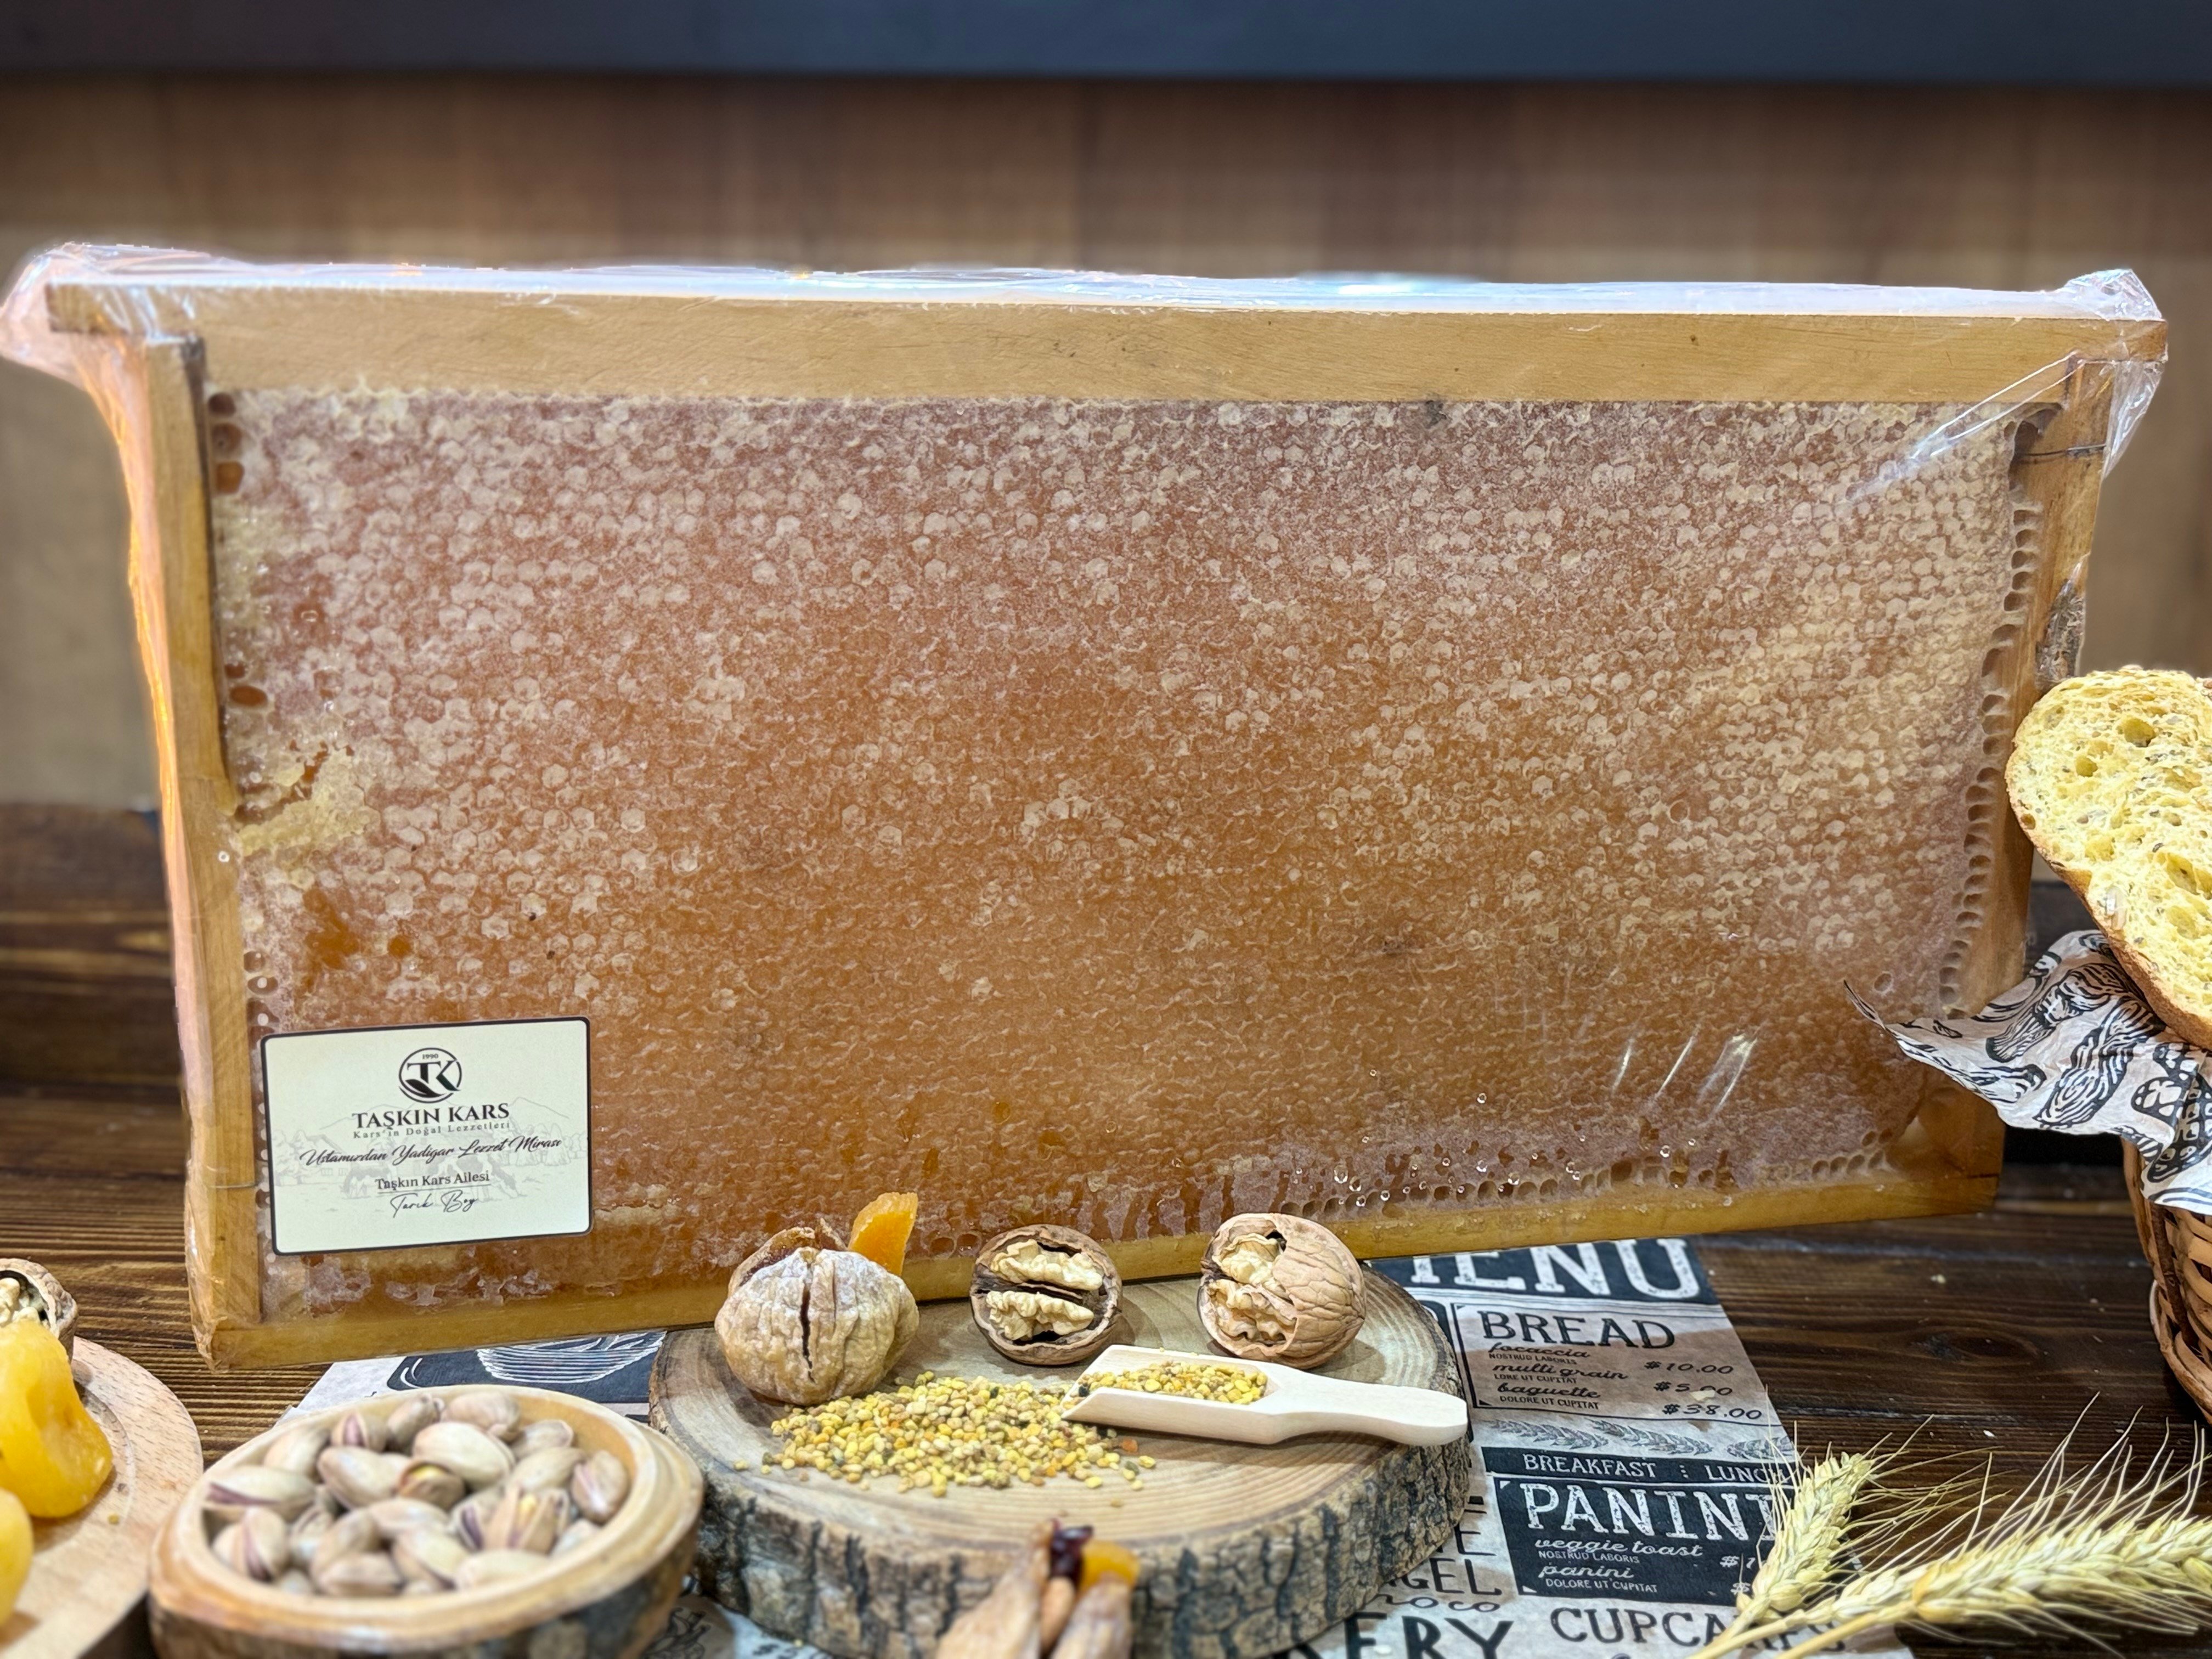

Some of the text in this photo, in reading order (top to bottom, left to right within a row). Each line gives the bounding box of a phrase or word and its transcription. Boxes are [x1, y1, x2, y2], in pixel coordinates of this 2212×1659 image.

[352, 1103, 510, 1130] TAŞKIN KARS
[406, 1127, 441, 1136] Doğal
[447, 1121, 510, 1132] Lezzetleri
[391, 1144, 455, 1166] Yadigar
[375, 1170, 490, 1190] Taşkın Kars Ailesi
[1411, 1239, 1701, 1299] ENU
[1477, 1310, 1676, 1349] BREAD
[1487, 1342, 1591, 1358] focaccia
[1492, 1363, 1629, 1379] multi grain
[1644, 1361, 1734, 1374] $10.00
[1497, 1382, 1601, 1398] baguette
[1499, 1395, 1540, 1404] DOLORE
[1662, 1403, 1763, 1419] $38.00
[1522, 1453, 1656, 1479] BREAKFAST
[1534, 1538, 1703, 1557] veggie toast
[1538, 1550, 1640, 1564] NOSTRUD LABORIS
[1538, 1565, 1635, 1579] panini
[1545, 1578, 1657, 1593] DOLORE UT CUPITAT
